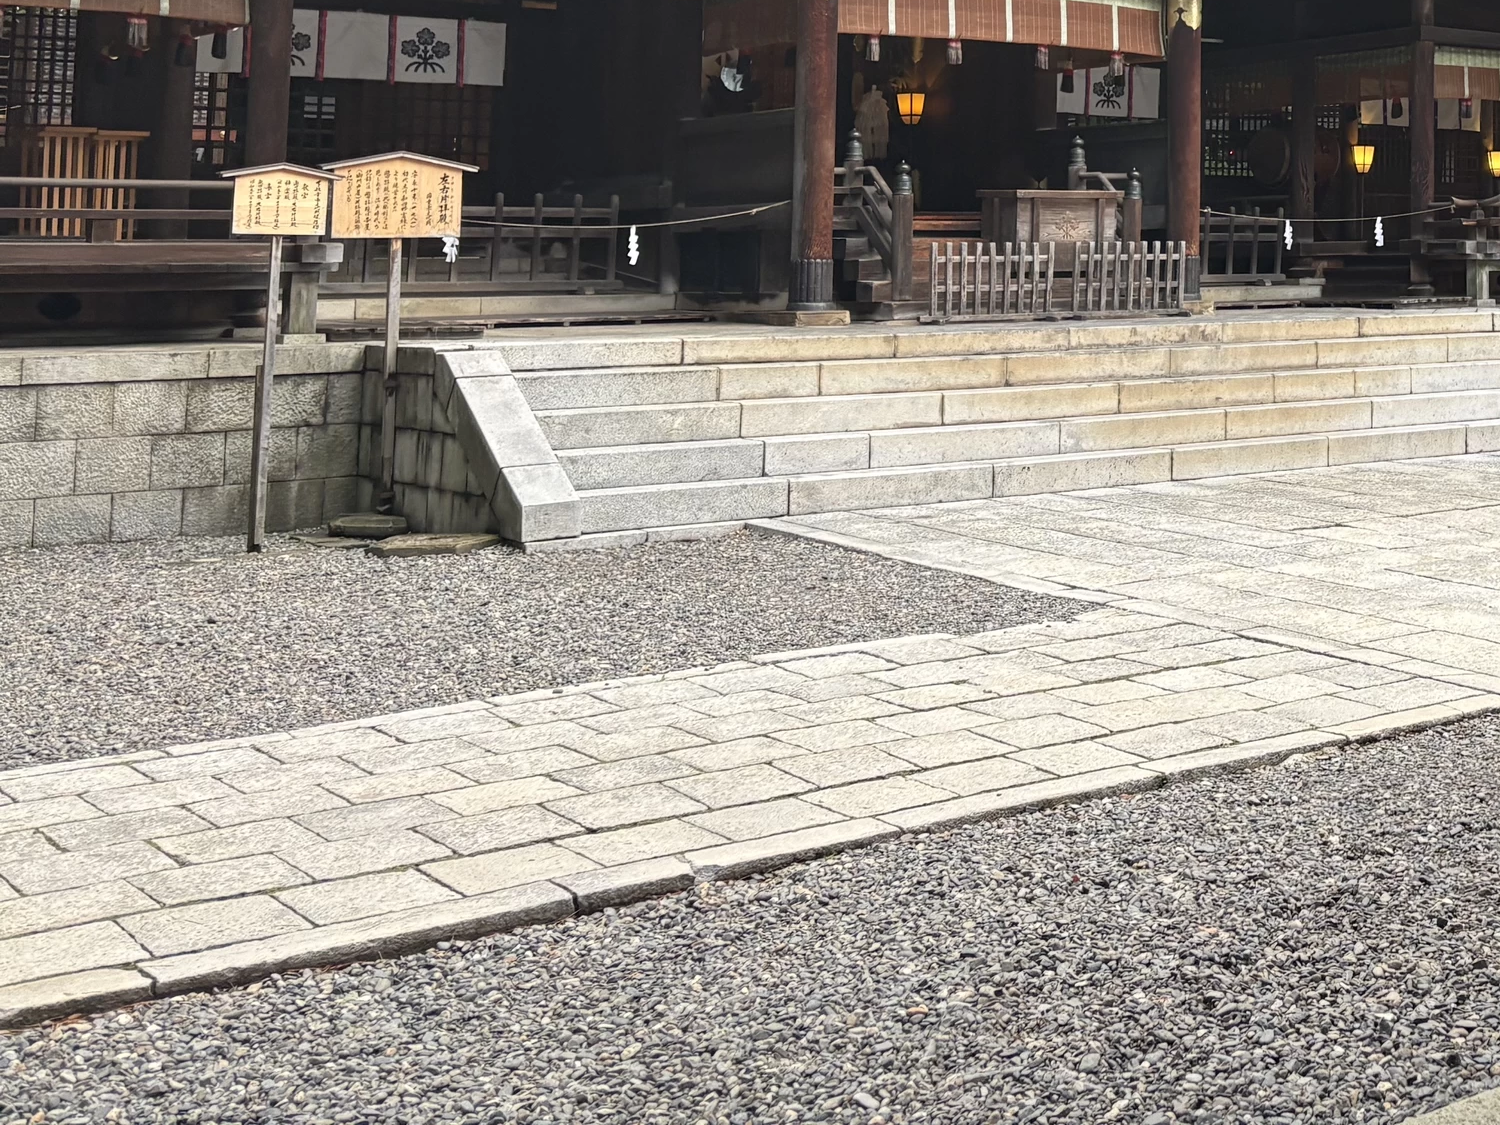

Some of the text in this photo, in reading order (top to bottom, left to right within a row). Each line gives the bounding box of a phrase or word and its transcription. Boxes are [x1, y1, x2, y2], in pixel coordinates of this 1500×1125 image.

[437, 173, 450, 225] 左右片拝殿
